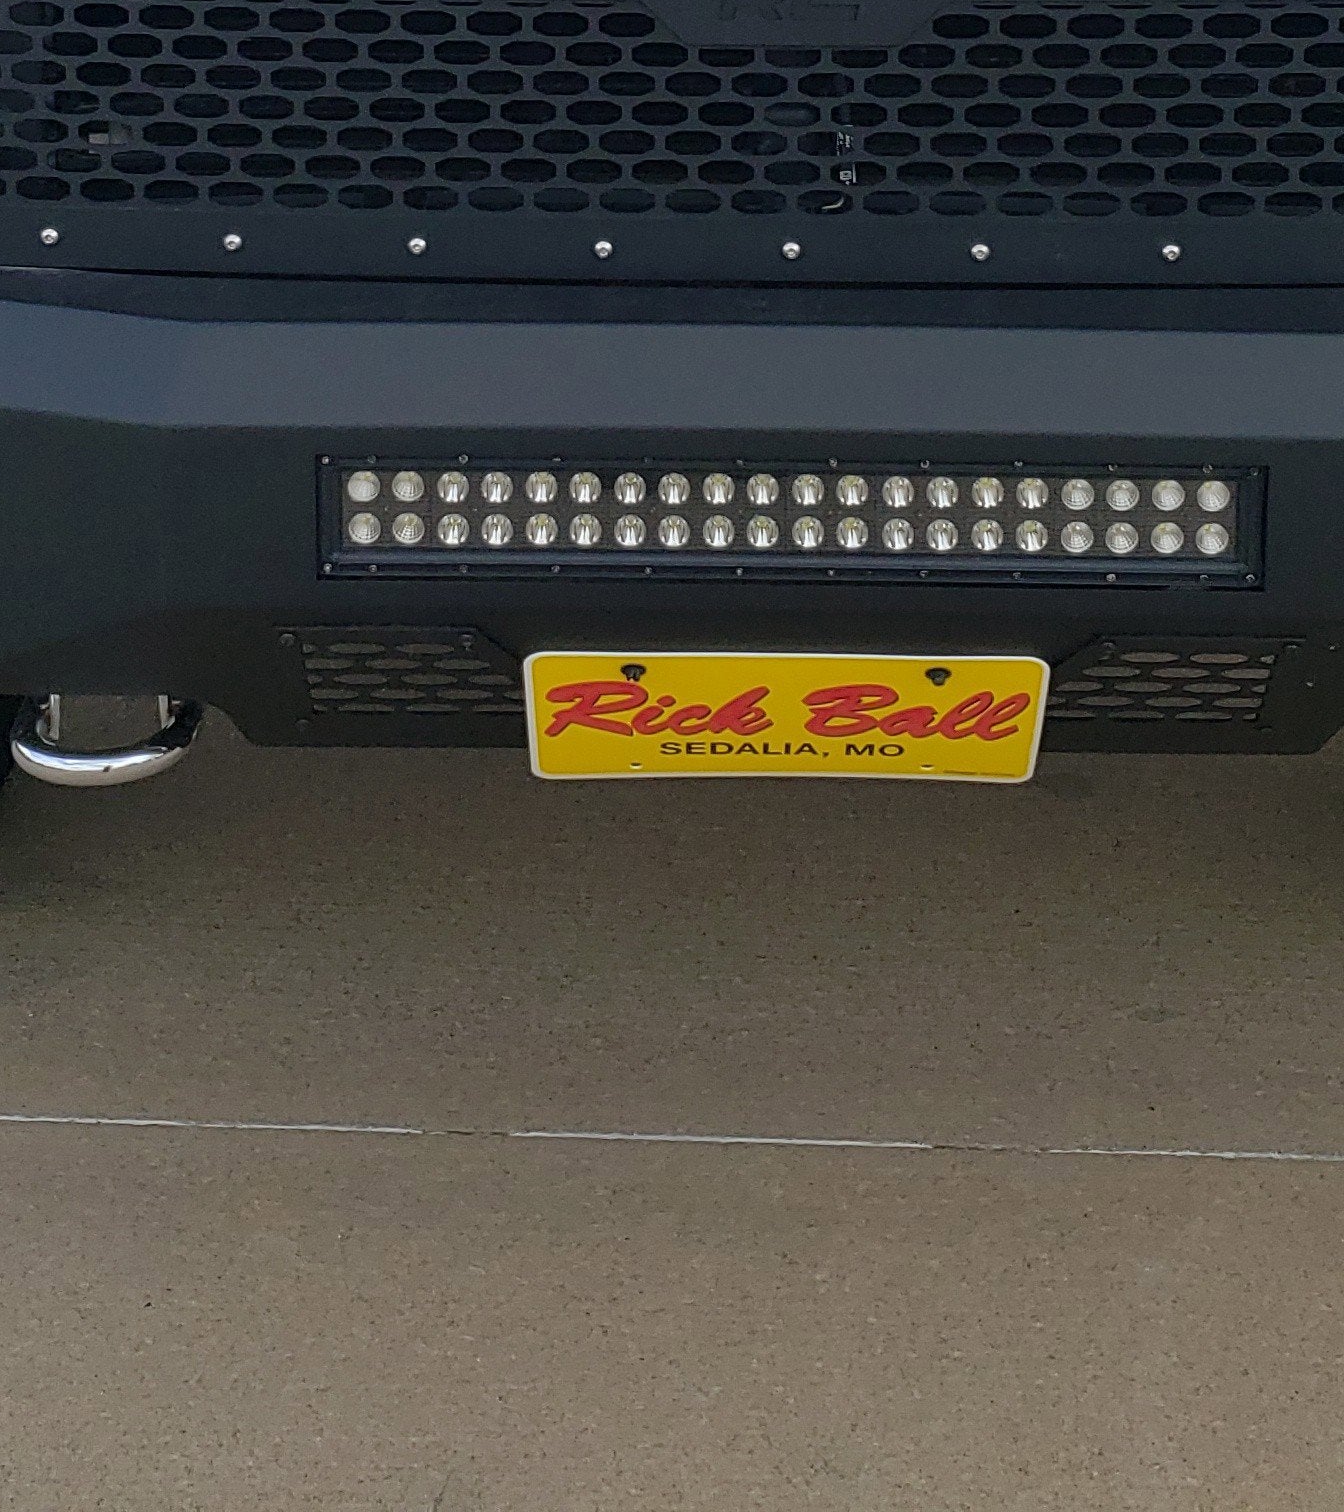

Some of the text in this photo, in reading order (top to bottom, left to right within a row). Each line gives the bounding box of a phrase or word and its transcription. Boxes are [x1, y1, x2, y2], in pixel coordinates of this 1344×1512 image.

[544, 680, 1031, 741] Rick Ball
[659, 741, 905, 758] SEDALIA, MO
